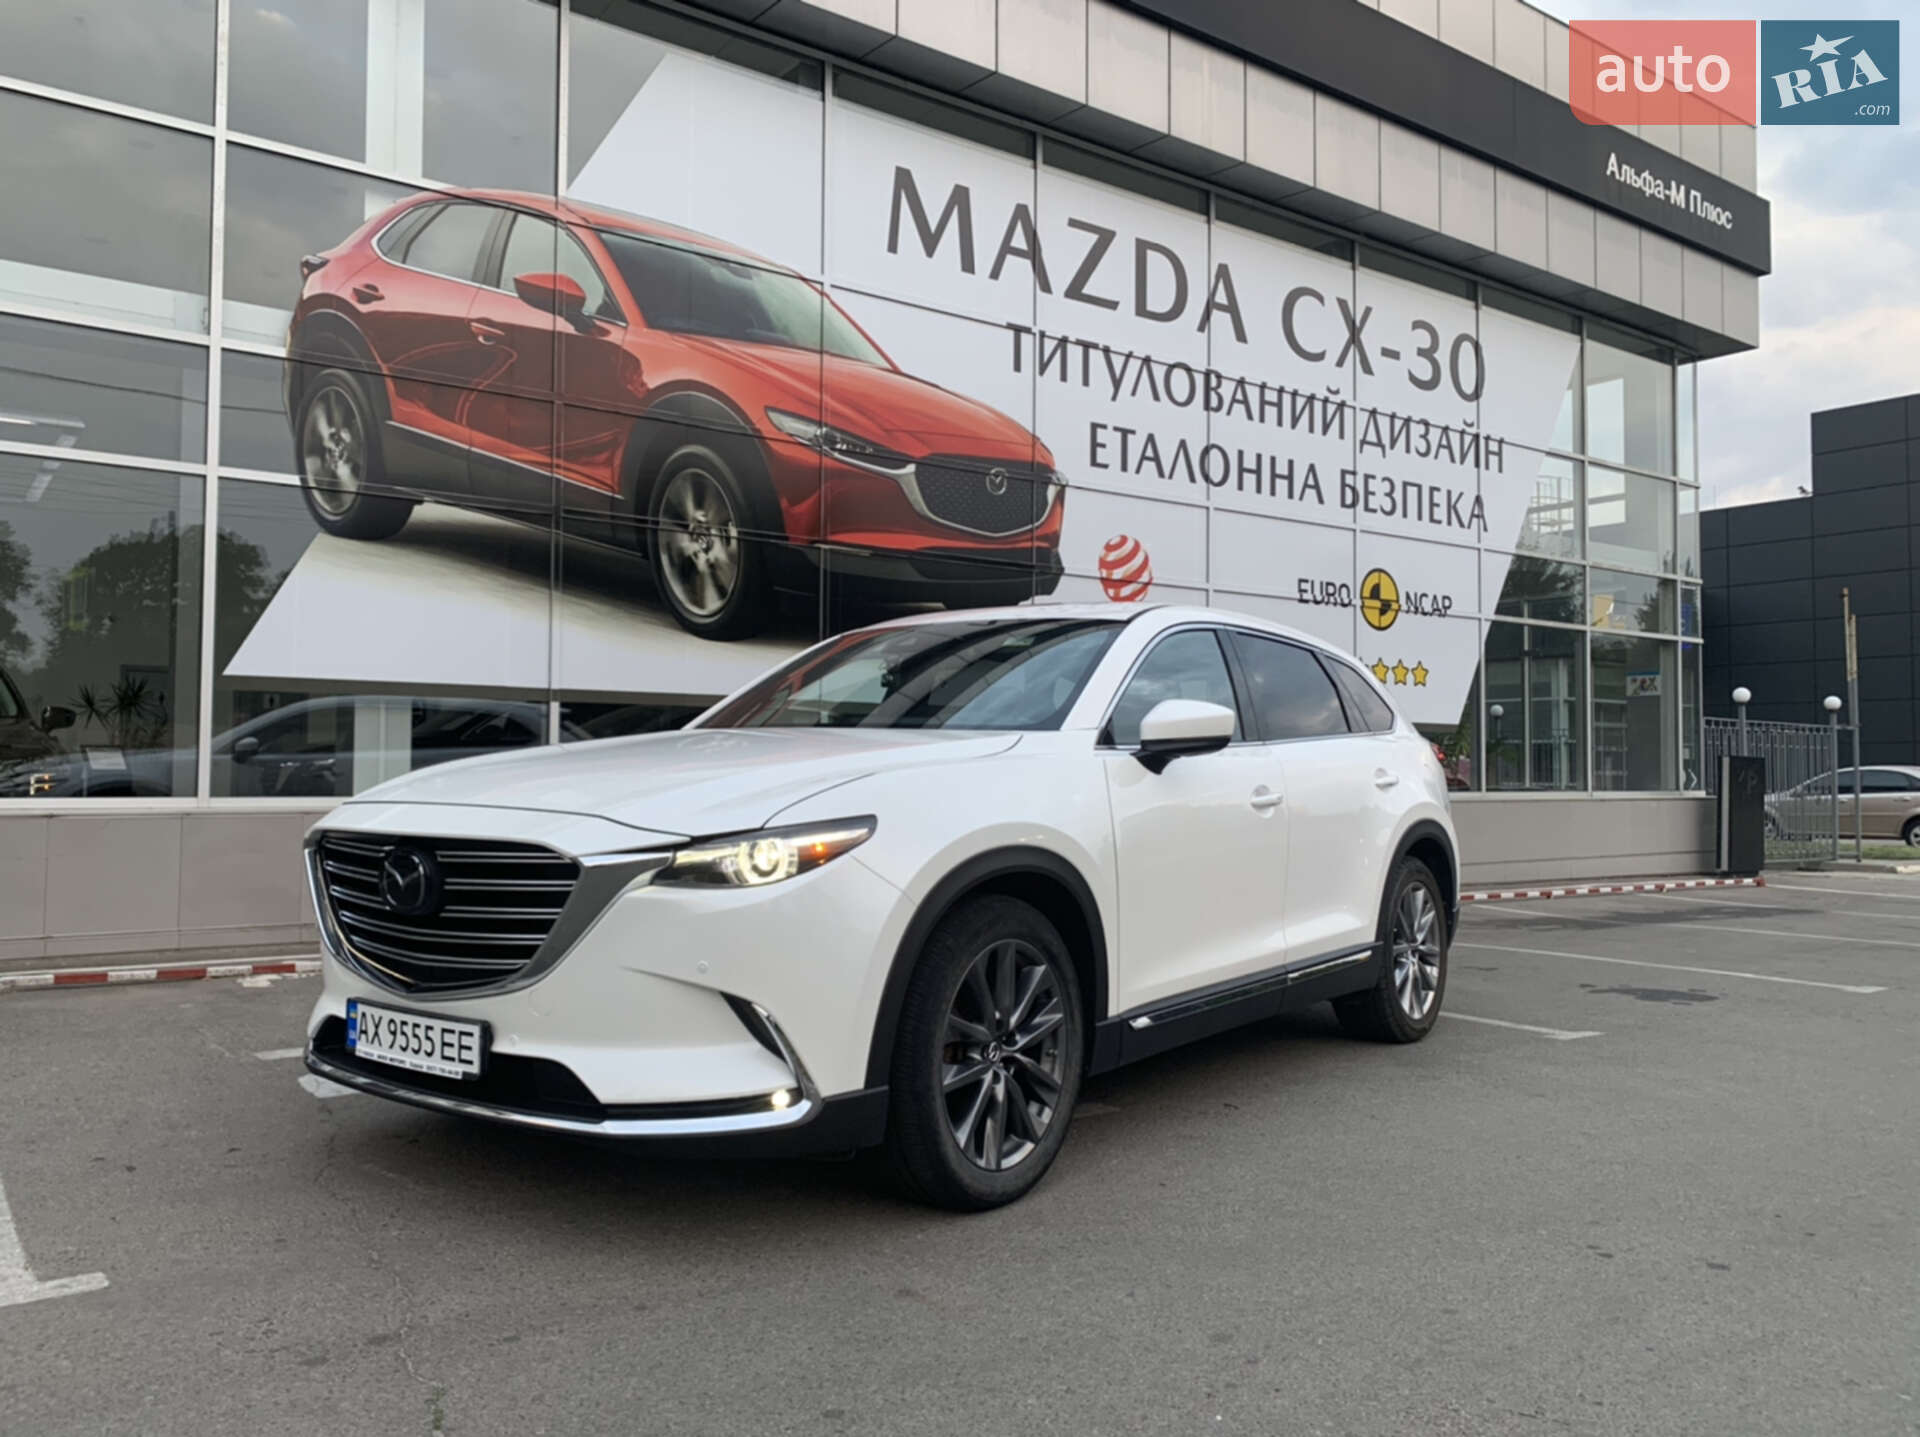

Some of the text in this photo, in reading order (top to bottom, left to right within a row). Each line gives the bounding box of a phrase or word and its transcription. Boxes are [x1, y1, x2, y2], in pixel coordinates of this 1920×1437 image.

[1605, 152, 1734, 230] Альфа-М Плюс
[886, 165, 1486, 403] MAZDA CX-30
[1005, 322, 1506, 475] ТИТУЛОВАНИЙ ДИЗАЙН
[1088, 421, 1489, 533] ЕТАЛОННА БЕЗПЕКА
[1297, 578, 1453, 618] EURO NCAP
[358, 1011, 383, 1047] AX
[387, 1018, 436, 1058] 9555
[440, 1028, 475, 1066] EE
